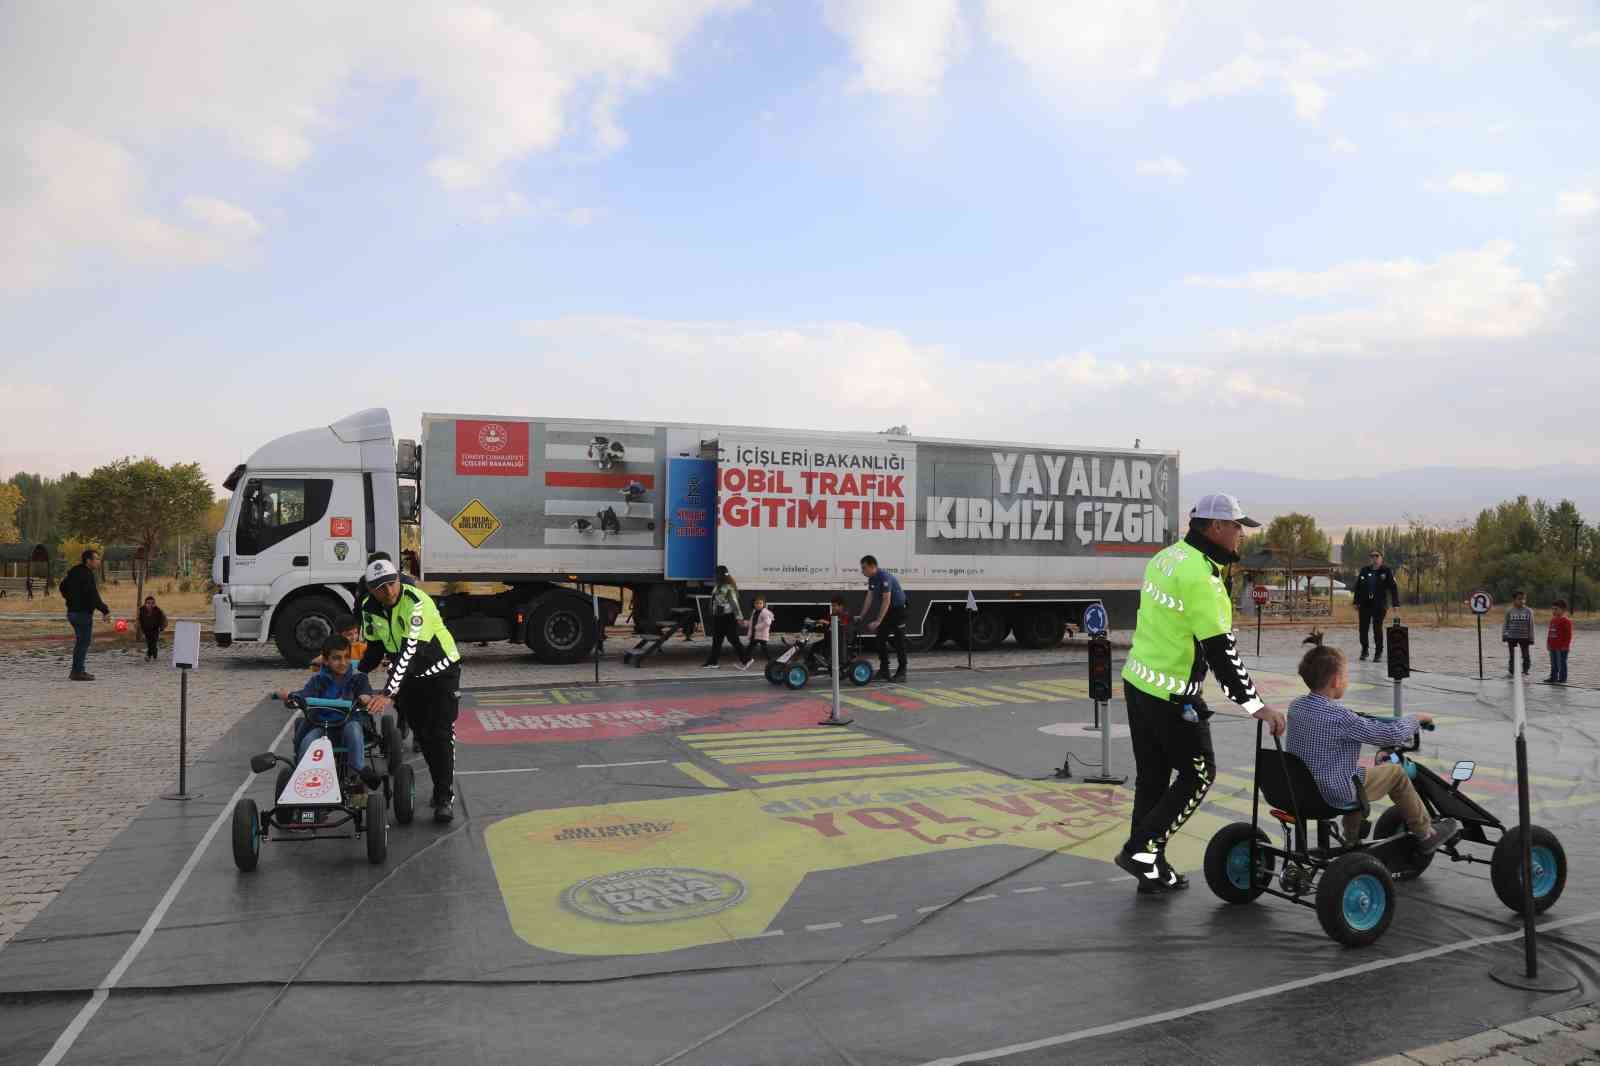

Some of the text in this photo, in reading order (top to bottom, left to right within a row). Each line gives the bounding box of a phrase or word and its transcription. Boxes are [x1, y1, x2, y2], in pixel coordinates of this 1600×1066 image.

[736, 446, 808, 467] İÇİŞLERİ
[814, 453, 905, 471] BAKANLIĞI
[717, 467, 904, 498] OBİL TRAFİK
[992, 452, 1152, 499] YAYALAR
[837, 500, 905, 531] TIRI
[926, 496, 1064, 541] KIRMIZI
[1252, 591, 1268, 599] DUR
[311, 749, 324, 762] 9
[780, 802, 976, 838] YOL
